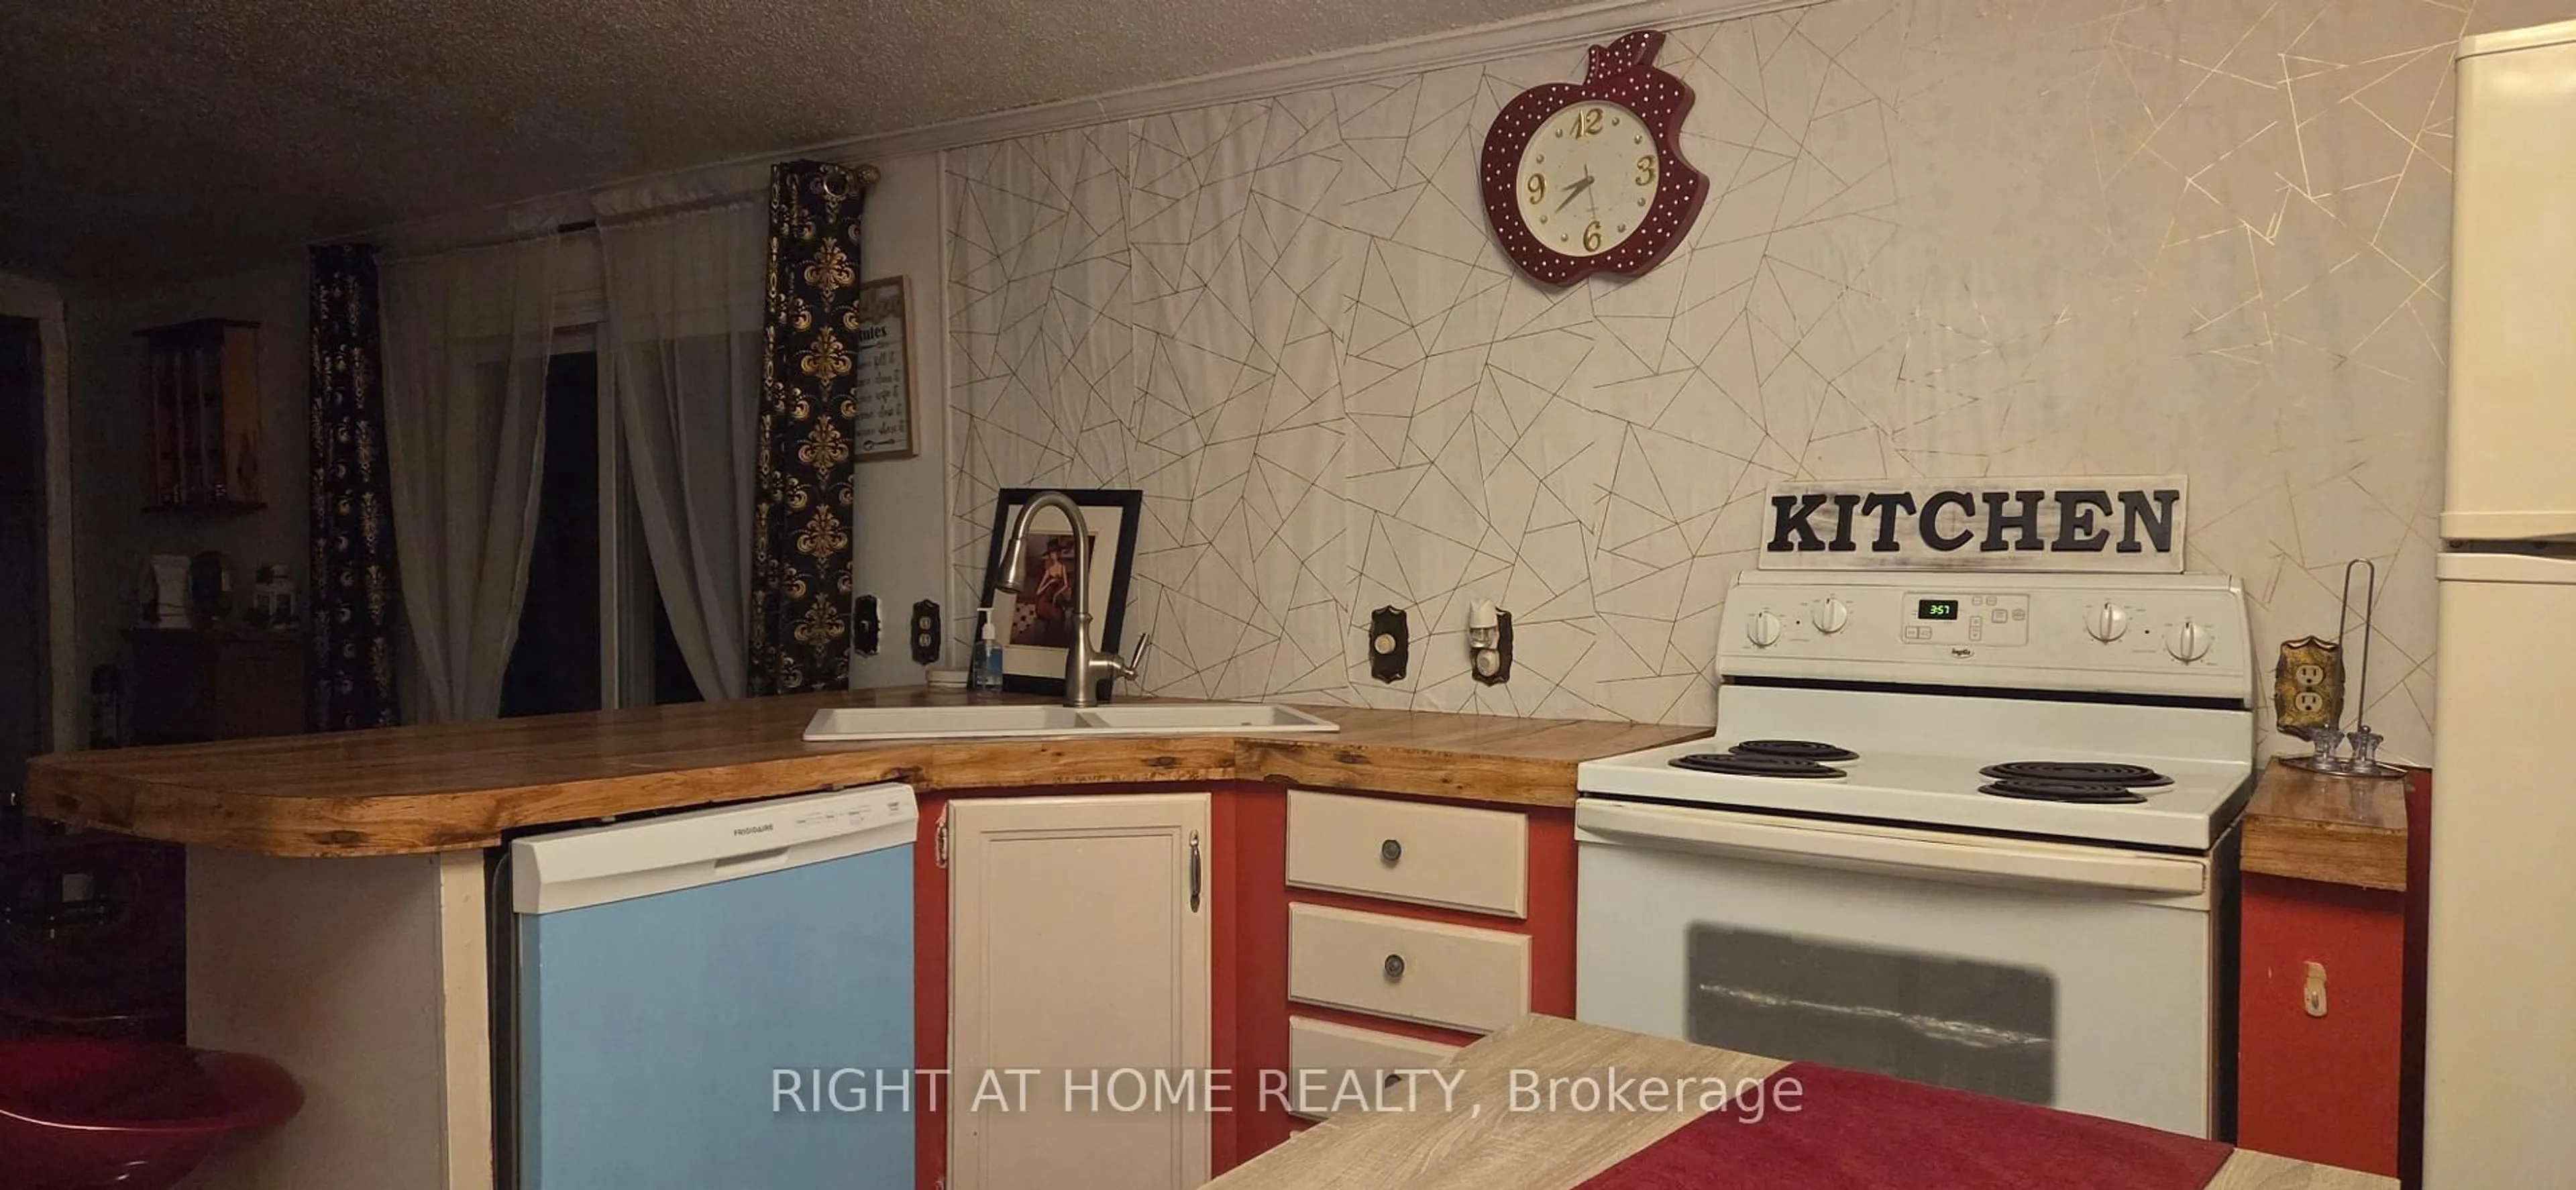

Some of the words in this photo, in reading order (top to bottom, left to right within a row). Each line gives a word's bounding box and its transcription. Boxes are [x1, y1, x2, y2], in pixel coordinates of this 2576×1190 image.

[1570, 108, 1604, 140] 12
[1635, 154, 1656, 186] 3
[1527, 173, 1546, 205] 9
[1583, 221, 1601, 252] 6
[1767, 490, 2180, 552] KITCHEN
[1929, 605, 1950, 614] 3:57
[734, 824, 773, 836] FRIGIDAIRE
